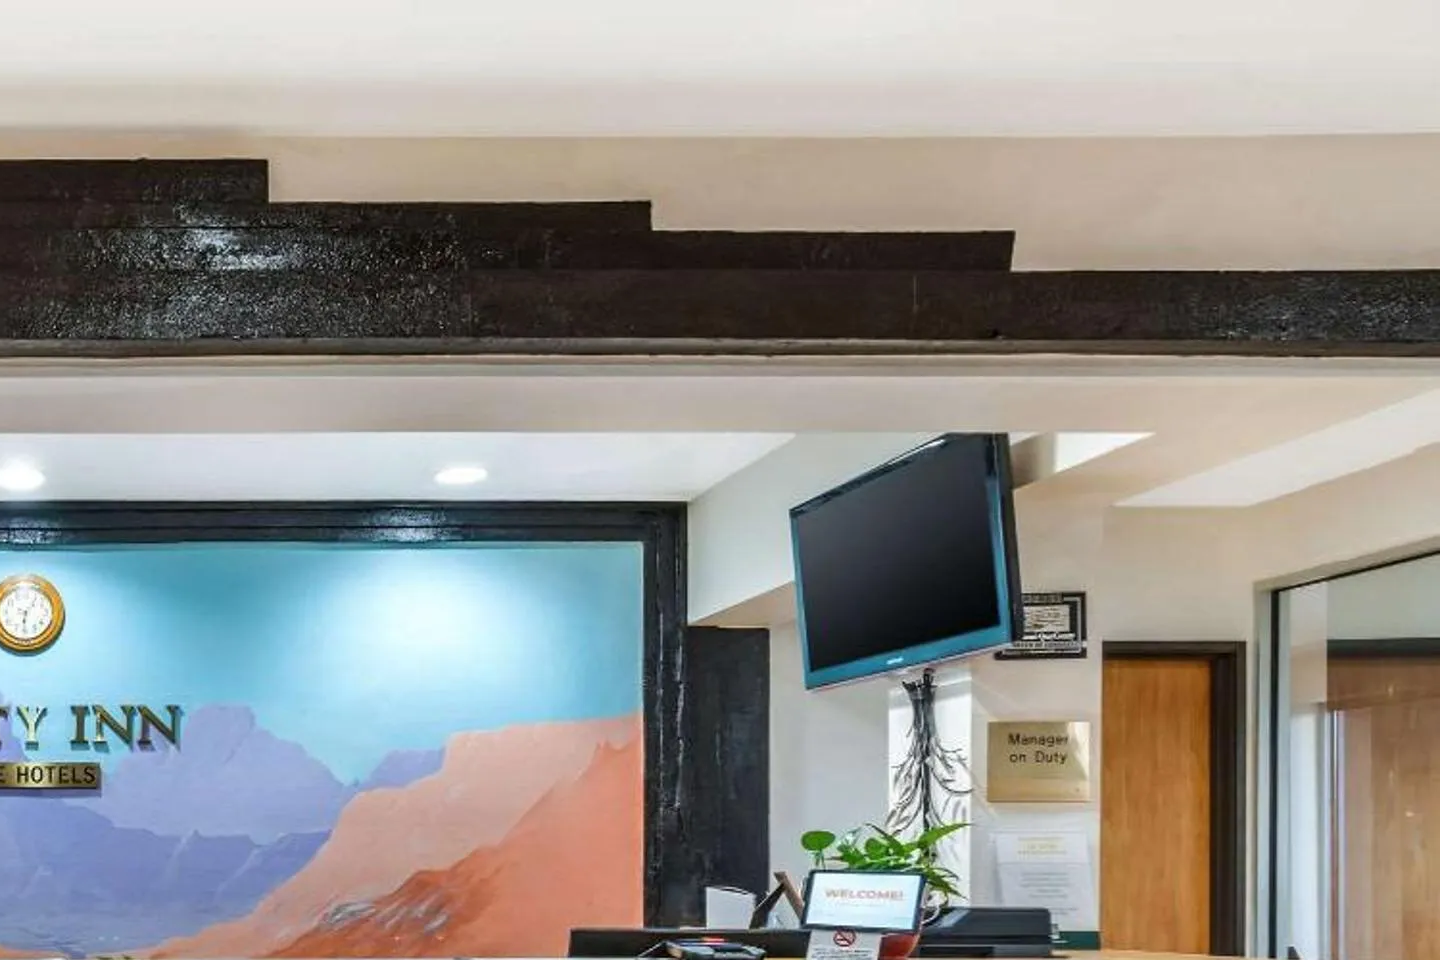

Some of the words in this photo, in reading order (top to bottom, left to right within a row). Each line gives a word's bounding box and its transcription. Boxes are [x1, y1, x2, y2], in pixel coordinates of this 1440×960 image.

[70, 704, 184, 750] INN
[1008, 732, 1068, 748] Manager
[1009, 753, 1027, 763] on
[1035, 750, 1067, 765] Duty
[16, 764, 96, 783] HOTELS
[825, 888, 904, 901] WELCOME!
